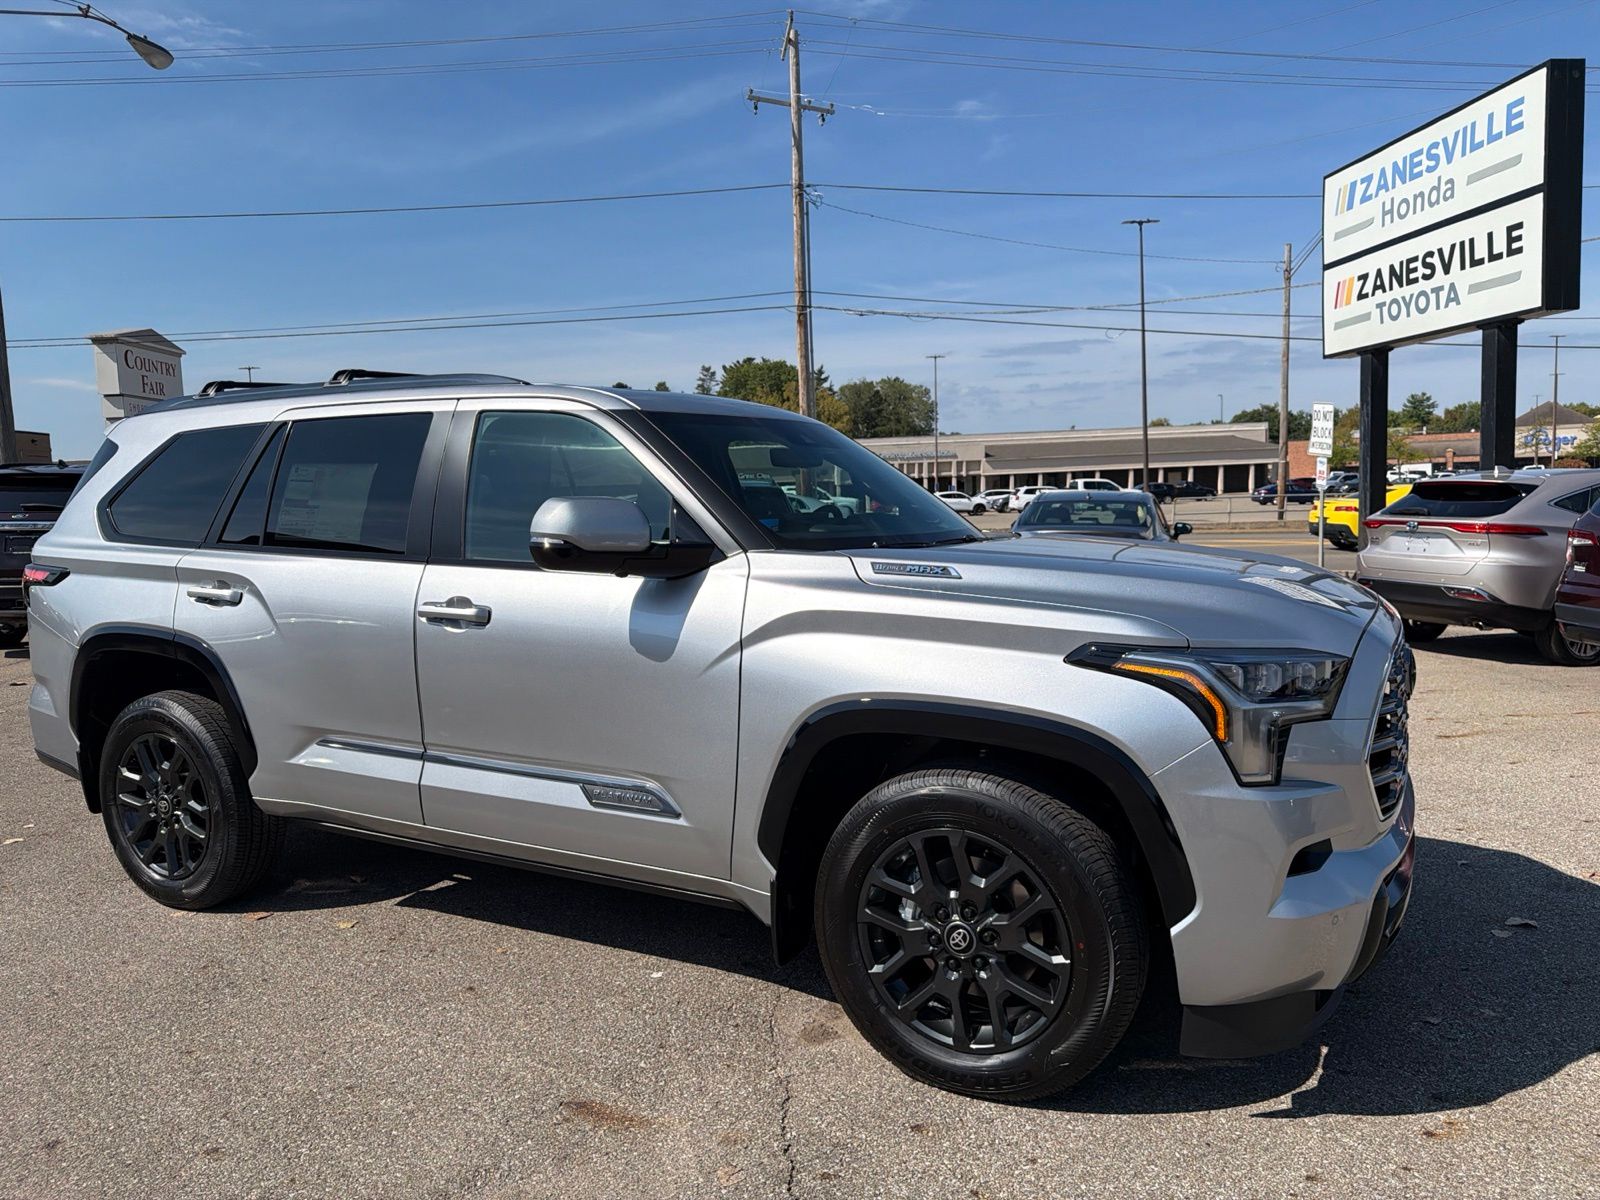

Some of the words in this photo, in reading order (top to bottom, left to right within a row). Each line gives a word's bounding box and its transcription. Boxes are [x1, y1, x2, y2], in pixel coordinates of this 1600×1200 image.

[1360, 96, 1525, 205] ZANESVILLE
[1381, 176, 1455, 228] Honda
[1356, 221, 1524, 301] ZANESVILLE
[1376, 282, 1461, 324] TOYOTA
[124, 349, 177, 378] COUNTRY
[141, 375, 166, 397] FAIR
[1313, 409, 1321, 421] DO
[906, 564, 946, 575] MAX
